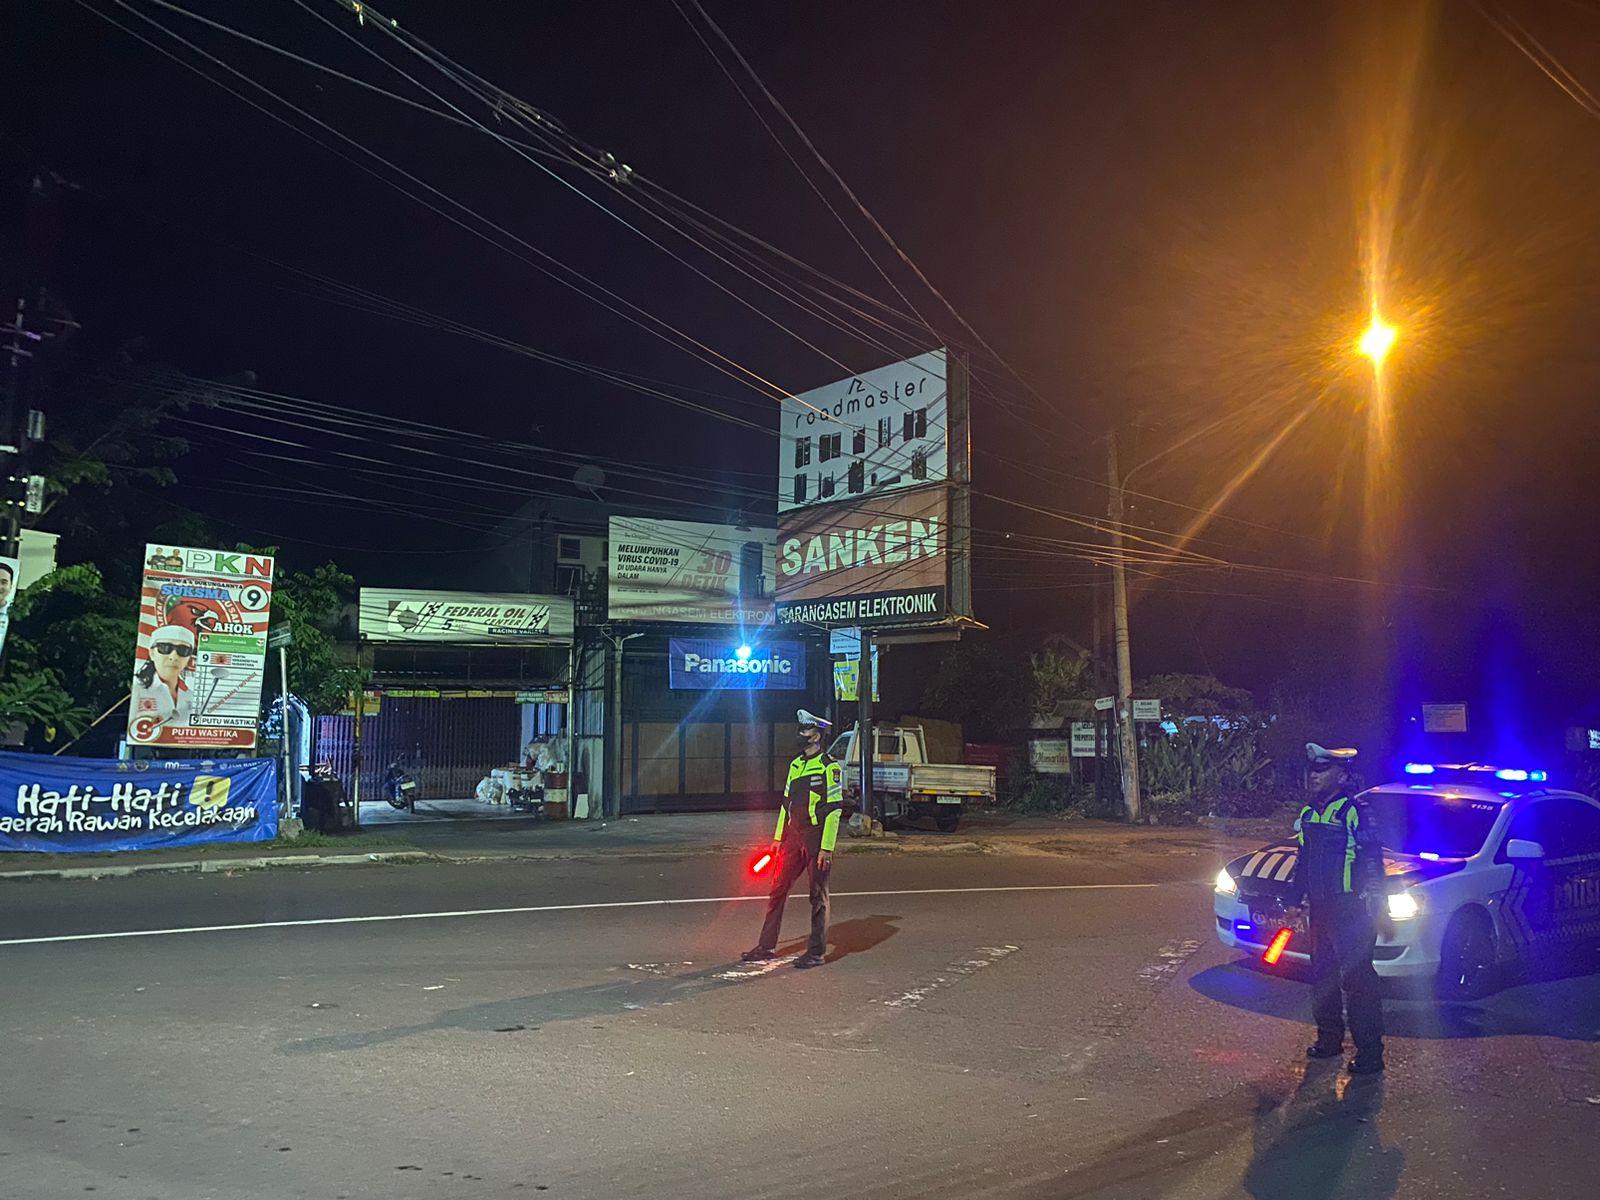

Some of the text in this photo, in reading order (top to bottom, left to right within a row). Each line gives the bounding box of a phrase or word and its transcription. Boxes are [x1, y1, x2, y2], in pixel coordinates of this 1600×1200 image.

[795, 377, 926, 428] roadmaster
[617, 544, 680, 557] MELUMPUHKAN
[781, 515, 940, 577] SANKEN
[185, 549, 272, 577] PKN
[617, 554, 680, 567] VIRUS COVID-19
[697, 549, 733, 575] 30
[617, 572, 640, 580] DALAM
[625, 564, 646, 572] UDARA
[646, 566, 668, 574] HANYA
[681, 574, 729, 590] DETIK
[160, 583, 231, 602] SUKSMA
[247, 589, 261, 608] 9
[442, 606, 528, 619] FEDERAL OIL
[858, 592, 938, 618] ELEKTRONIK
[213, 621, 253, 635] AHOK
[484, 617, 522, 627] CENTER
[202, 653, 210, 663] 9
[684, 652, 791, 674] Panasonic
[202, 717, 221, 725] PUTU
[223, 718, 256, 726] WASTIKA
[171, 728, 238, 738] PUTU WASTIKA
[17, 782, 182, 821] Hati-Hati
[0, 802, 256, 834] aerah Rawan Kecelakaan
